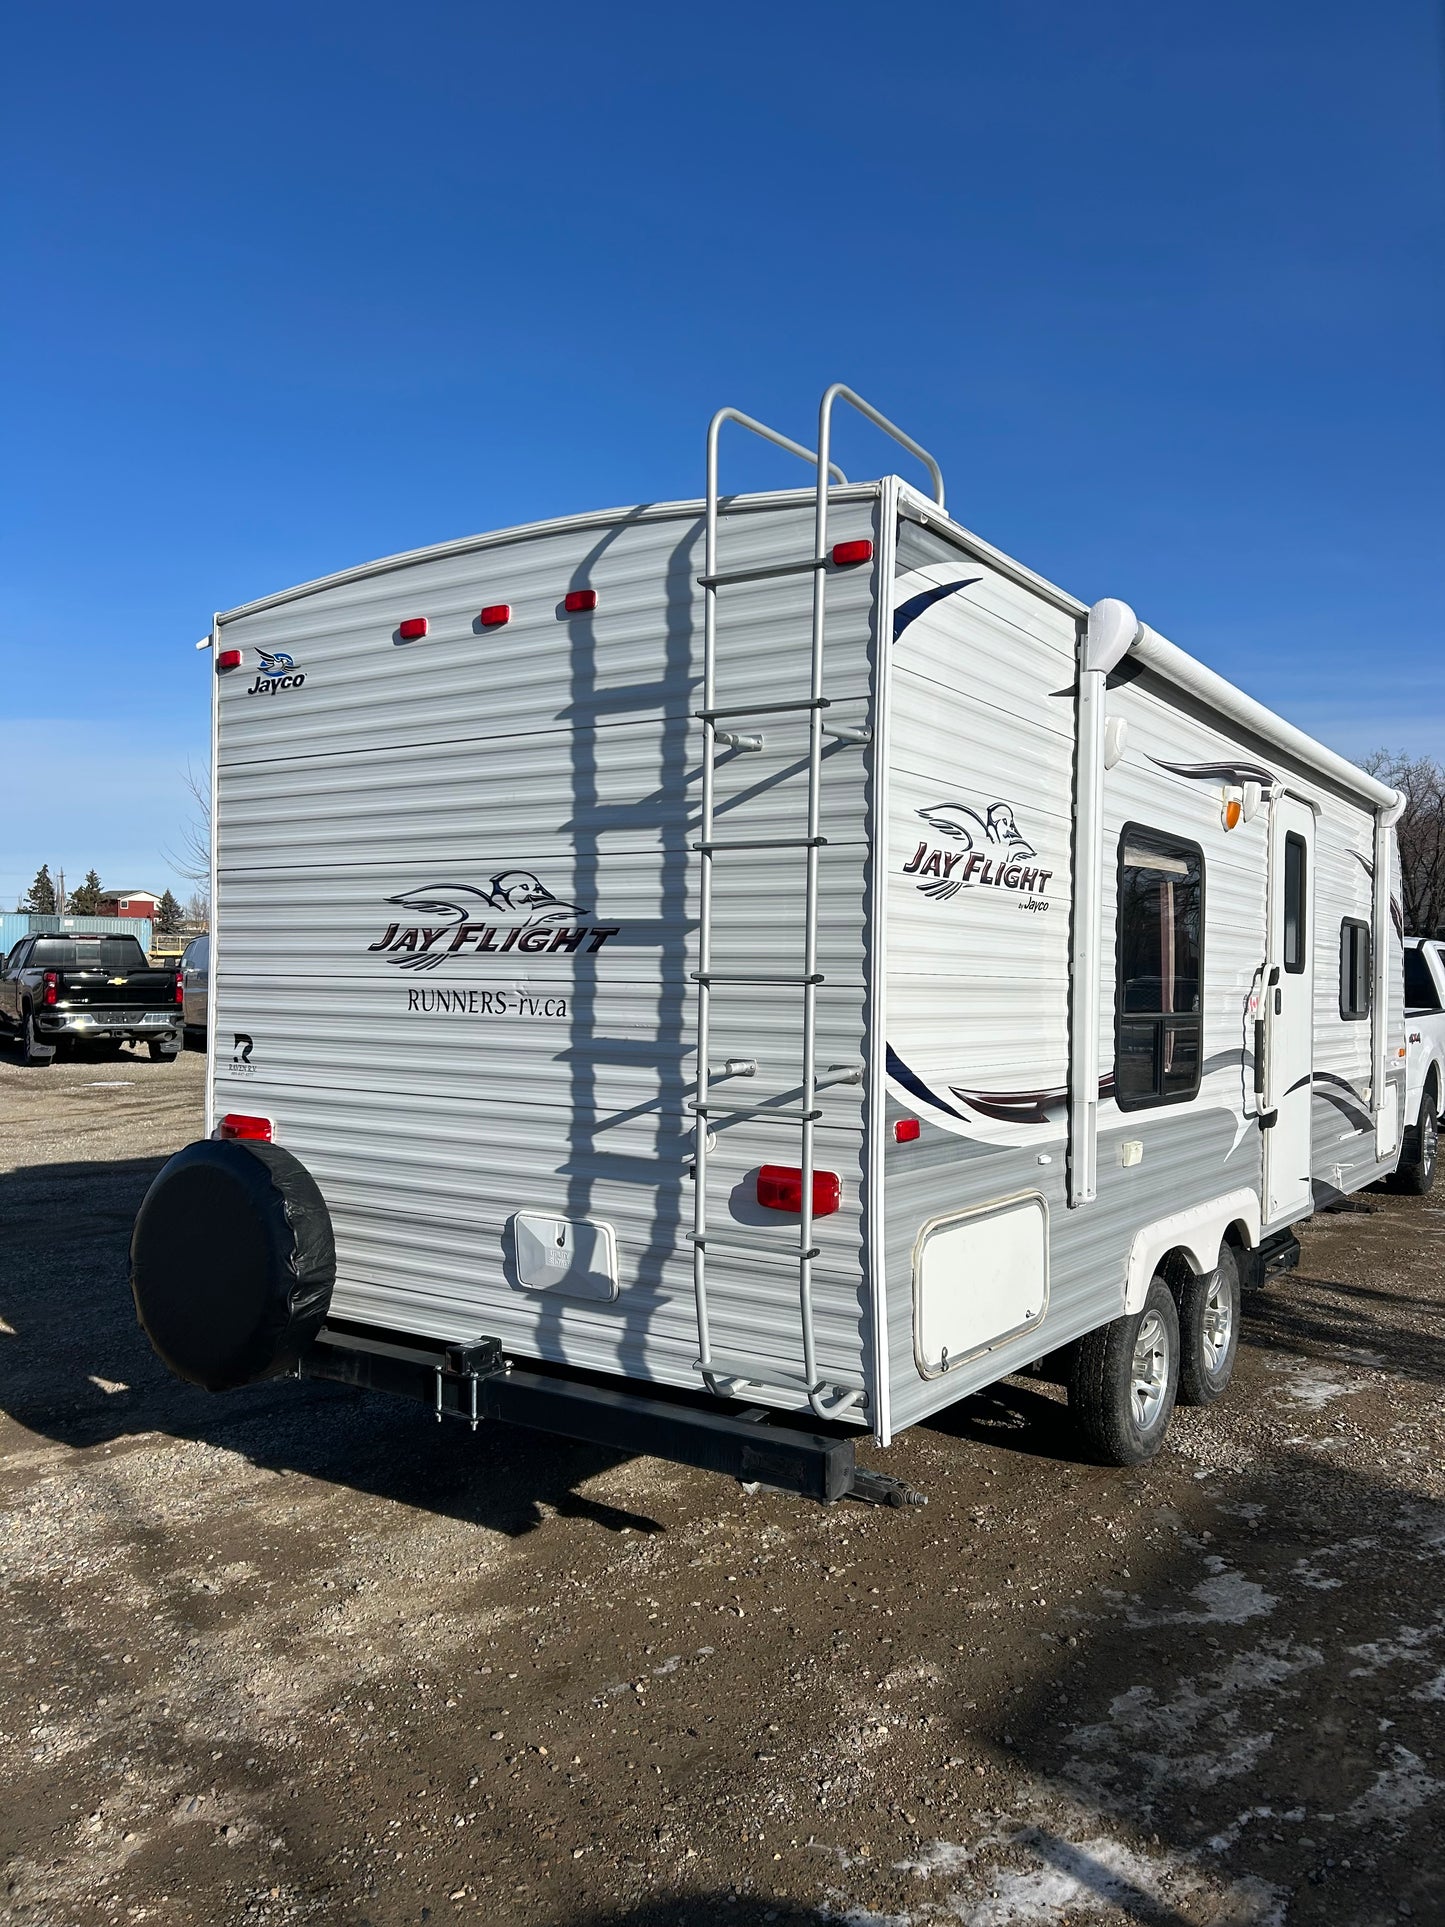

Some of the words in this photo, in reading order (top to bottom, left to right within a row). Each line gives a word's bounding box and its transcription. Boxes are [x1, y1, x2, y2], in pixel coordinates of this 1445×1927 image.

[247, 673, 306, 696] Jayco
[903, 841, 964, 878] JAY
[962, 851, 1054, 893] FLIGHT
[1024, 896, 1049, 913] Jayco
[367, 923, 450, 952] JAY
[447, 923, 621, 953] FLIGHT
[407, 988, 567, 1018] RUNNERS-rv.ca
